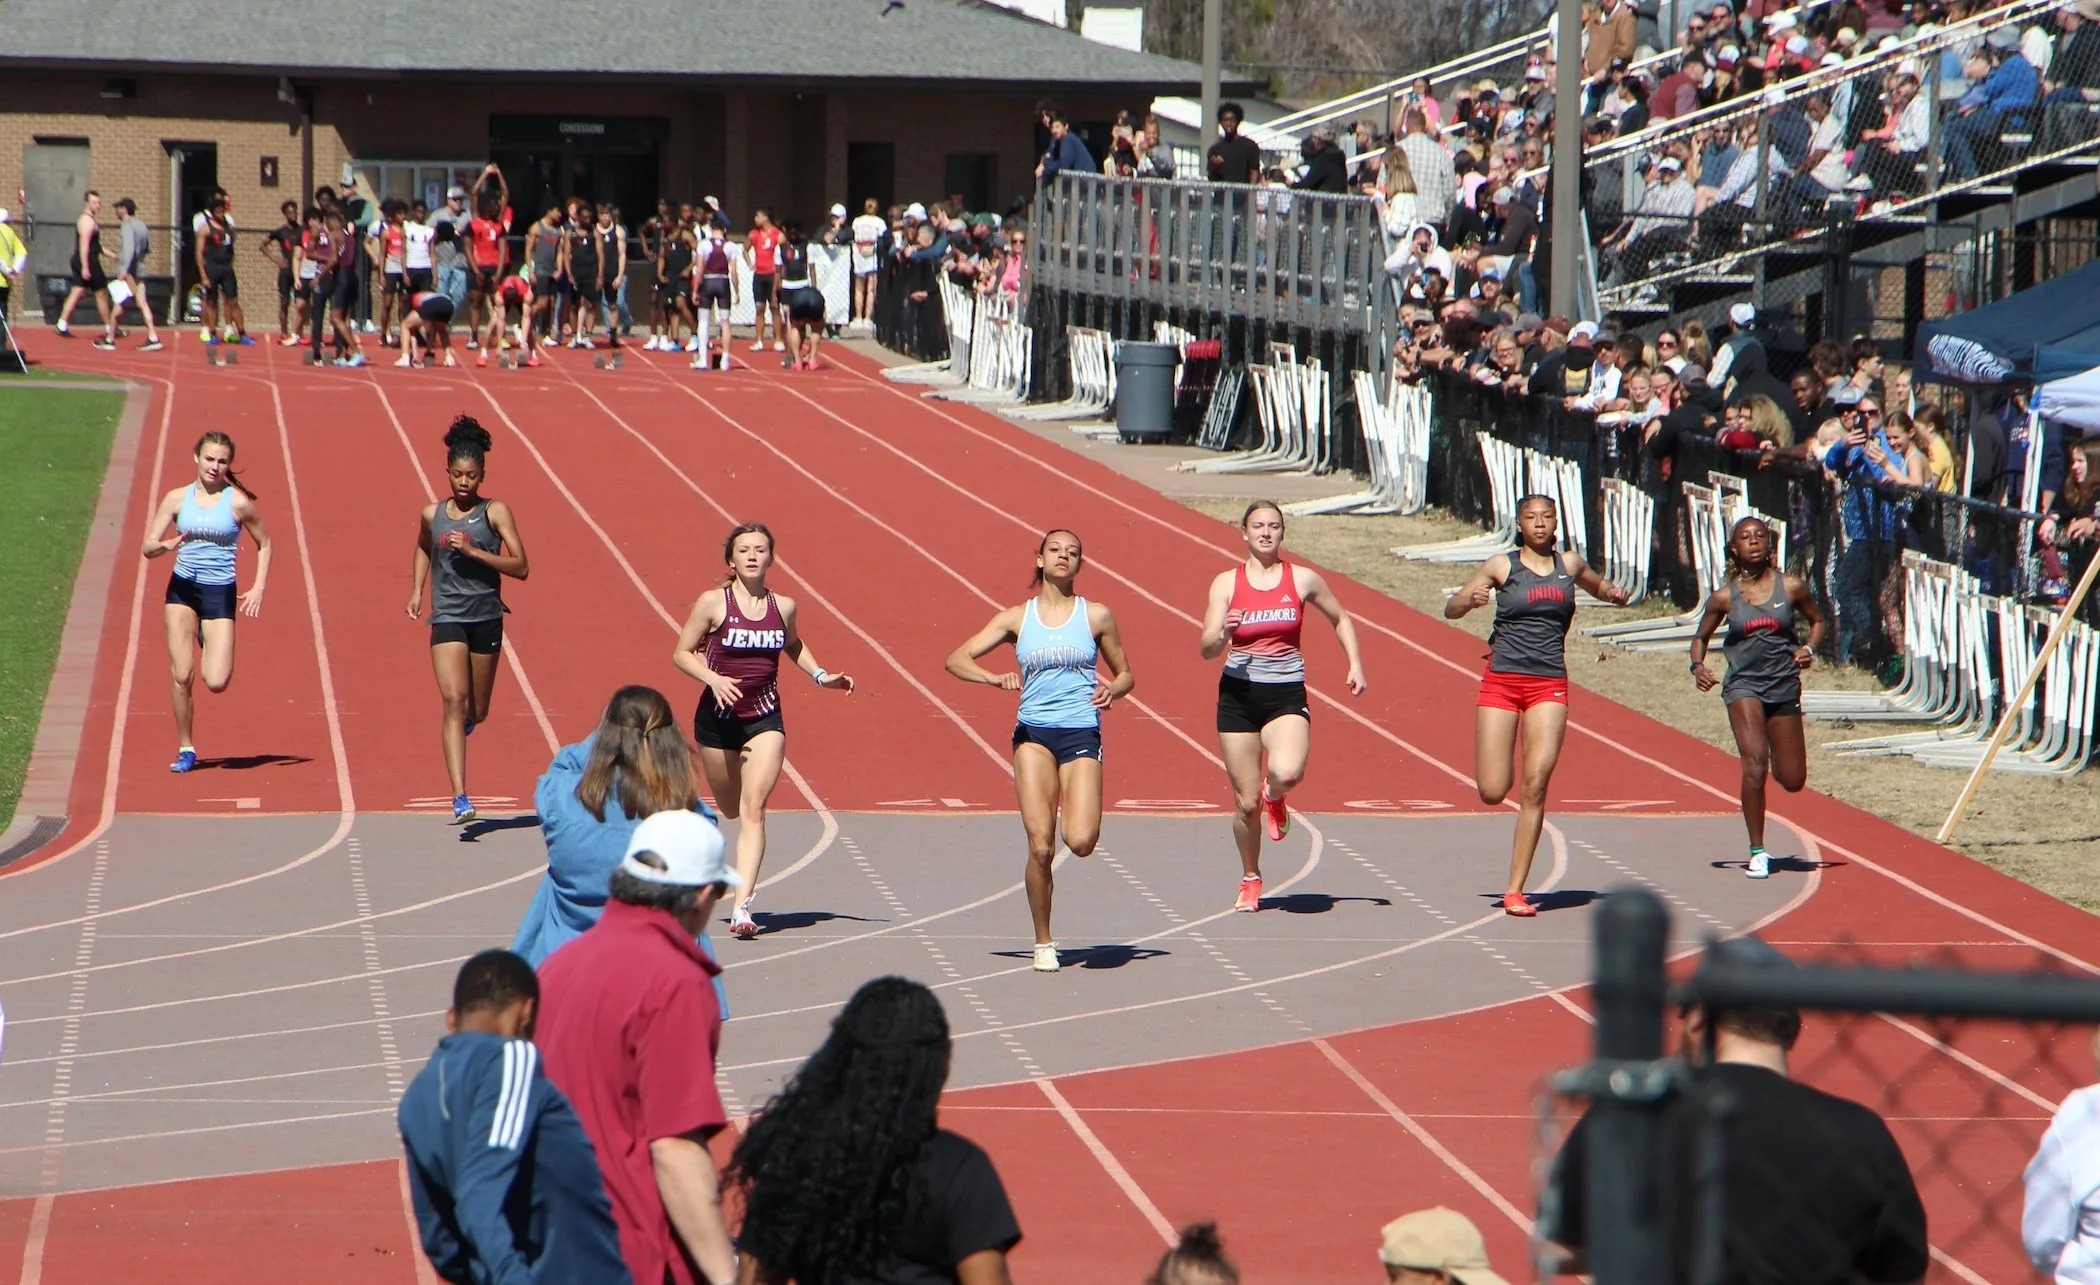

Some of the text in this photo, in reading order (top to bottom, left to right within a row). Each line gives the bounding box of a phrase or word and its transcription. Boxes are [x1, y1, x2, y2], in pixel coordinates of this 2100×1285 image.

[1527, 585, 1565, 605] UNION
[1241, 607, 1297, 625] LAREMORE
[1743, 616, 1780, 635] UNION
[721, 628, 784, 649] JENKS
